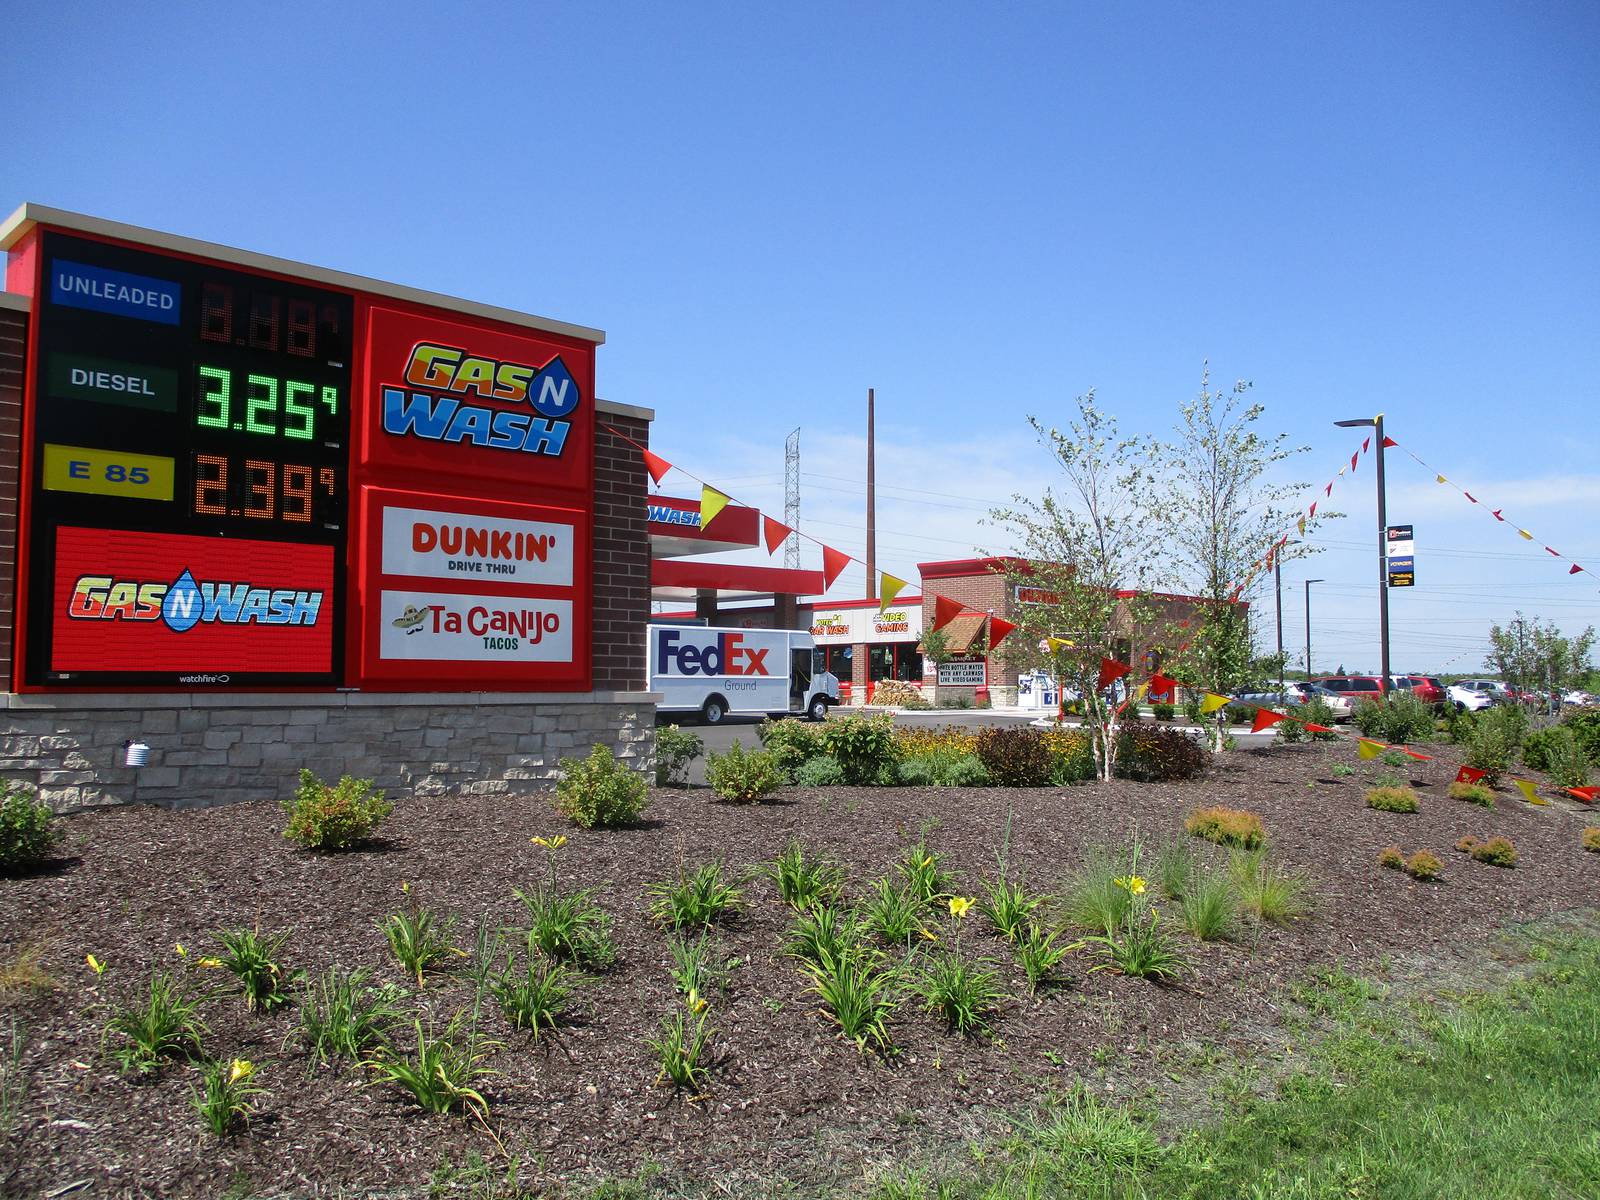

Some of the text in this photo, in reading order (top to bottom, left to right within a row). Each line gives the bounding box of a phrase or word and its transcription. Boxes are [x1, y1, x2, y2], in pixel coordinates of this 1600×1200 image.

[59, 273, 174, 310] UNLEADED
[71, 368, 155, 396] DIESEL
[406, 345, 569, 407] GAS N
[384, 389, 571, 456] WASH
[69, 460, 150, 485] E 85
[412, 522, 556, 563] DUNKIN'
[448, 560, 516, 575] DRIVE THRU
[69, 577, 323, 626] GAS N WASH
[875, 623, 908, 633] GAMING
[881, 612, 907, 622] VIDEO
[826, 625, 849, 635] WASH
[483, 637, 518, 650] TACOS
[658, 630, 769, 676] FedEx
[179, 675, 217, 683] watchfire
[724, 680, 757, 691] Ground
